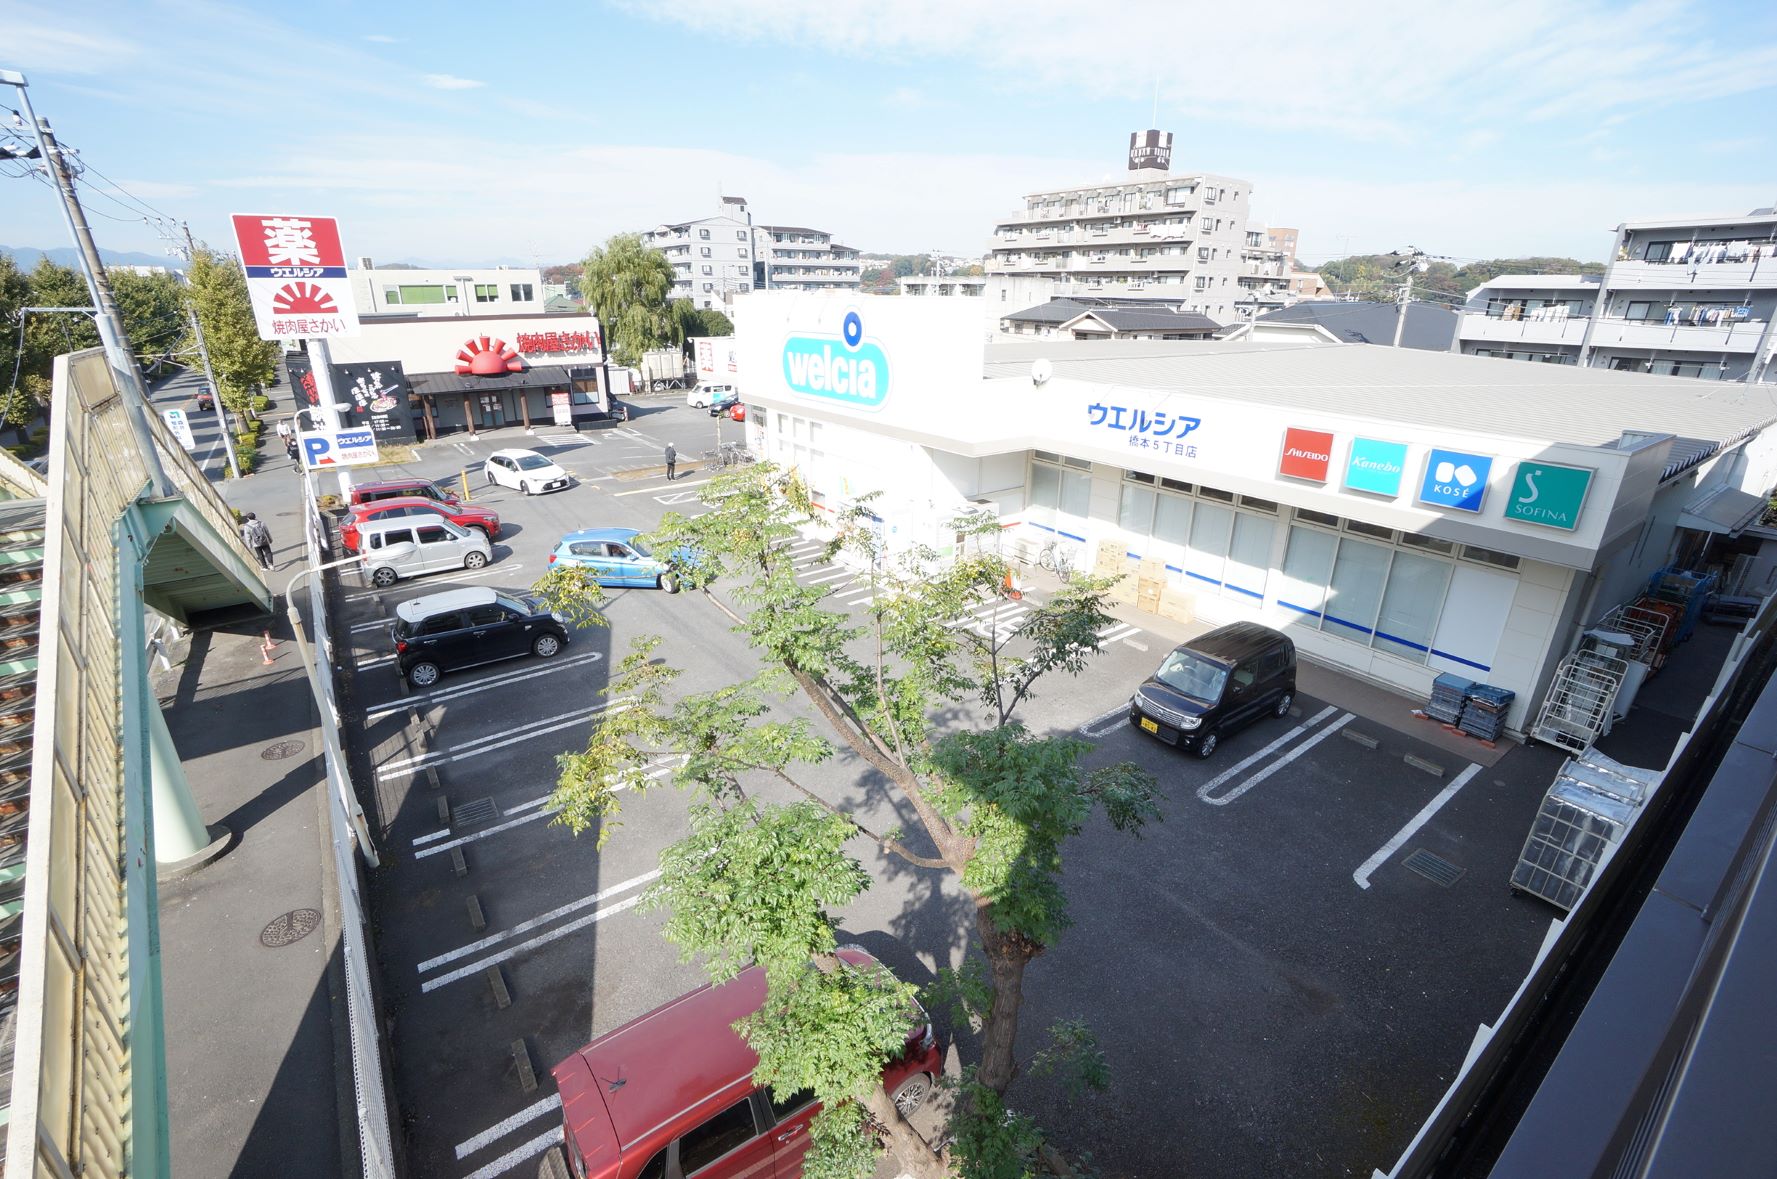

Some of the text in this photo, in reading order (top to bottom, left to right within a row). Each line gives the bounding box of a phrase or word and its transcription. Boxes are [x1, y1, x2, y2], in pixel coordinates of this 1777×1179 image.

[261, 218, 320, 264] 薬
[270, 268, 324, 277] ウエルシア
[272, 318, 346, 335] 焼肉屋さかい
[787, 311, 877, 400] welcia
[1088, 403, 1202, 439] ウエルシア
[338, 436, 372, 444] ウエルシア
[304, 438, 330, 465] P
[1285, 447, 1328, 462] SHISEIDO
[1353, 455, 1401, 473] Kanebo
[1514, 503, 1567, 522] SOFINA
